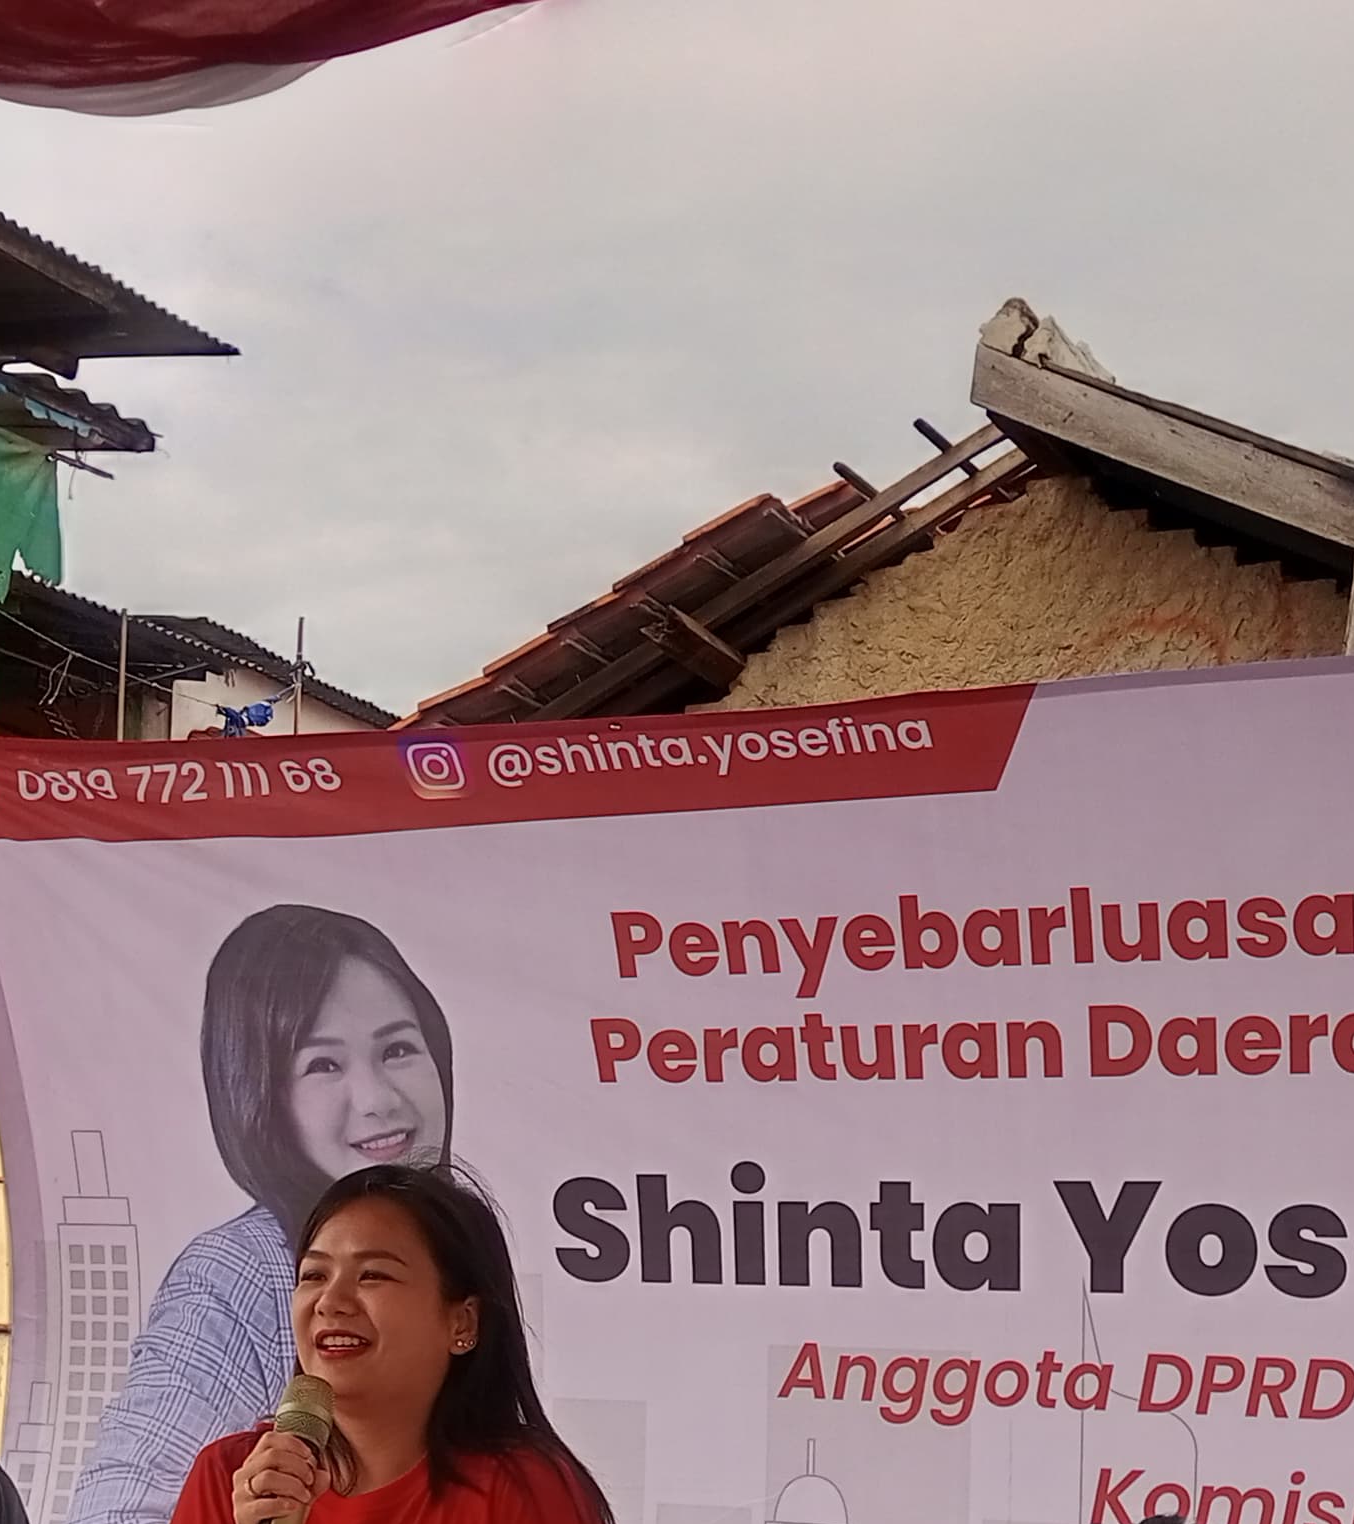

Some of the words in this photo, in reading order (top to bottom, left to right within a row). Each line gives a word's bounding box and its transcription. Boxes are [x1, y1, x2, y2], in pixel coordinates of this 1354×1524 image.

[17, 768, 118, 802] 0819
[126, 761, 208, 803] 772
[215, 761, 270, 799] 111
[279, 758, 341, 793] 68
[487, 717, 934, 788] @shinta.yosefina
[589, 1011, 1065, 1083] Peraturan
[552, 1160, 1022, 1293] Shinta
[778, 1340, 1115, 1426] Anggota
